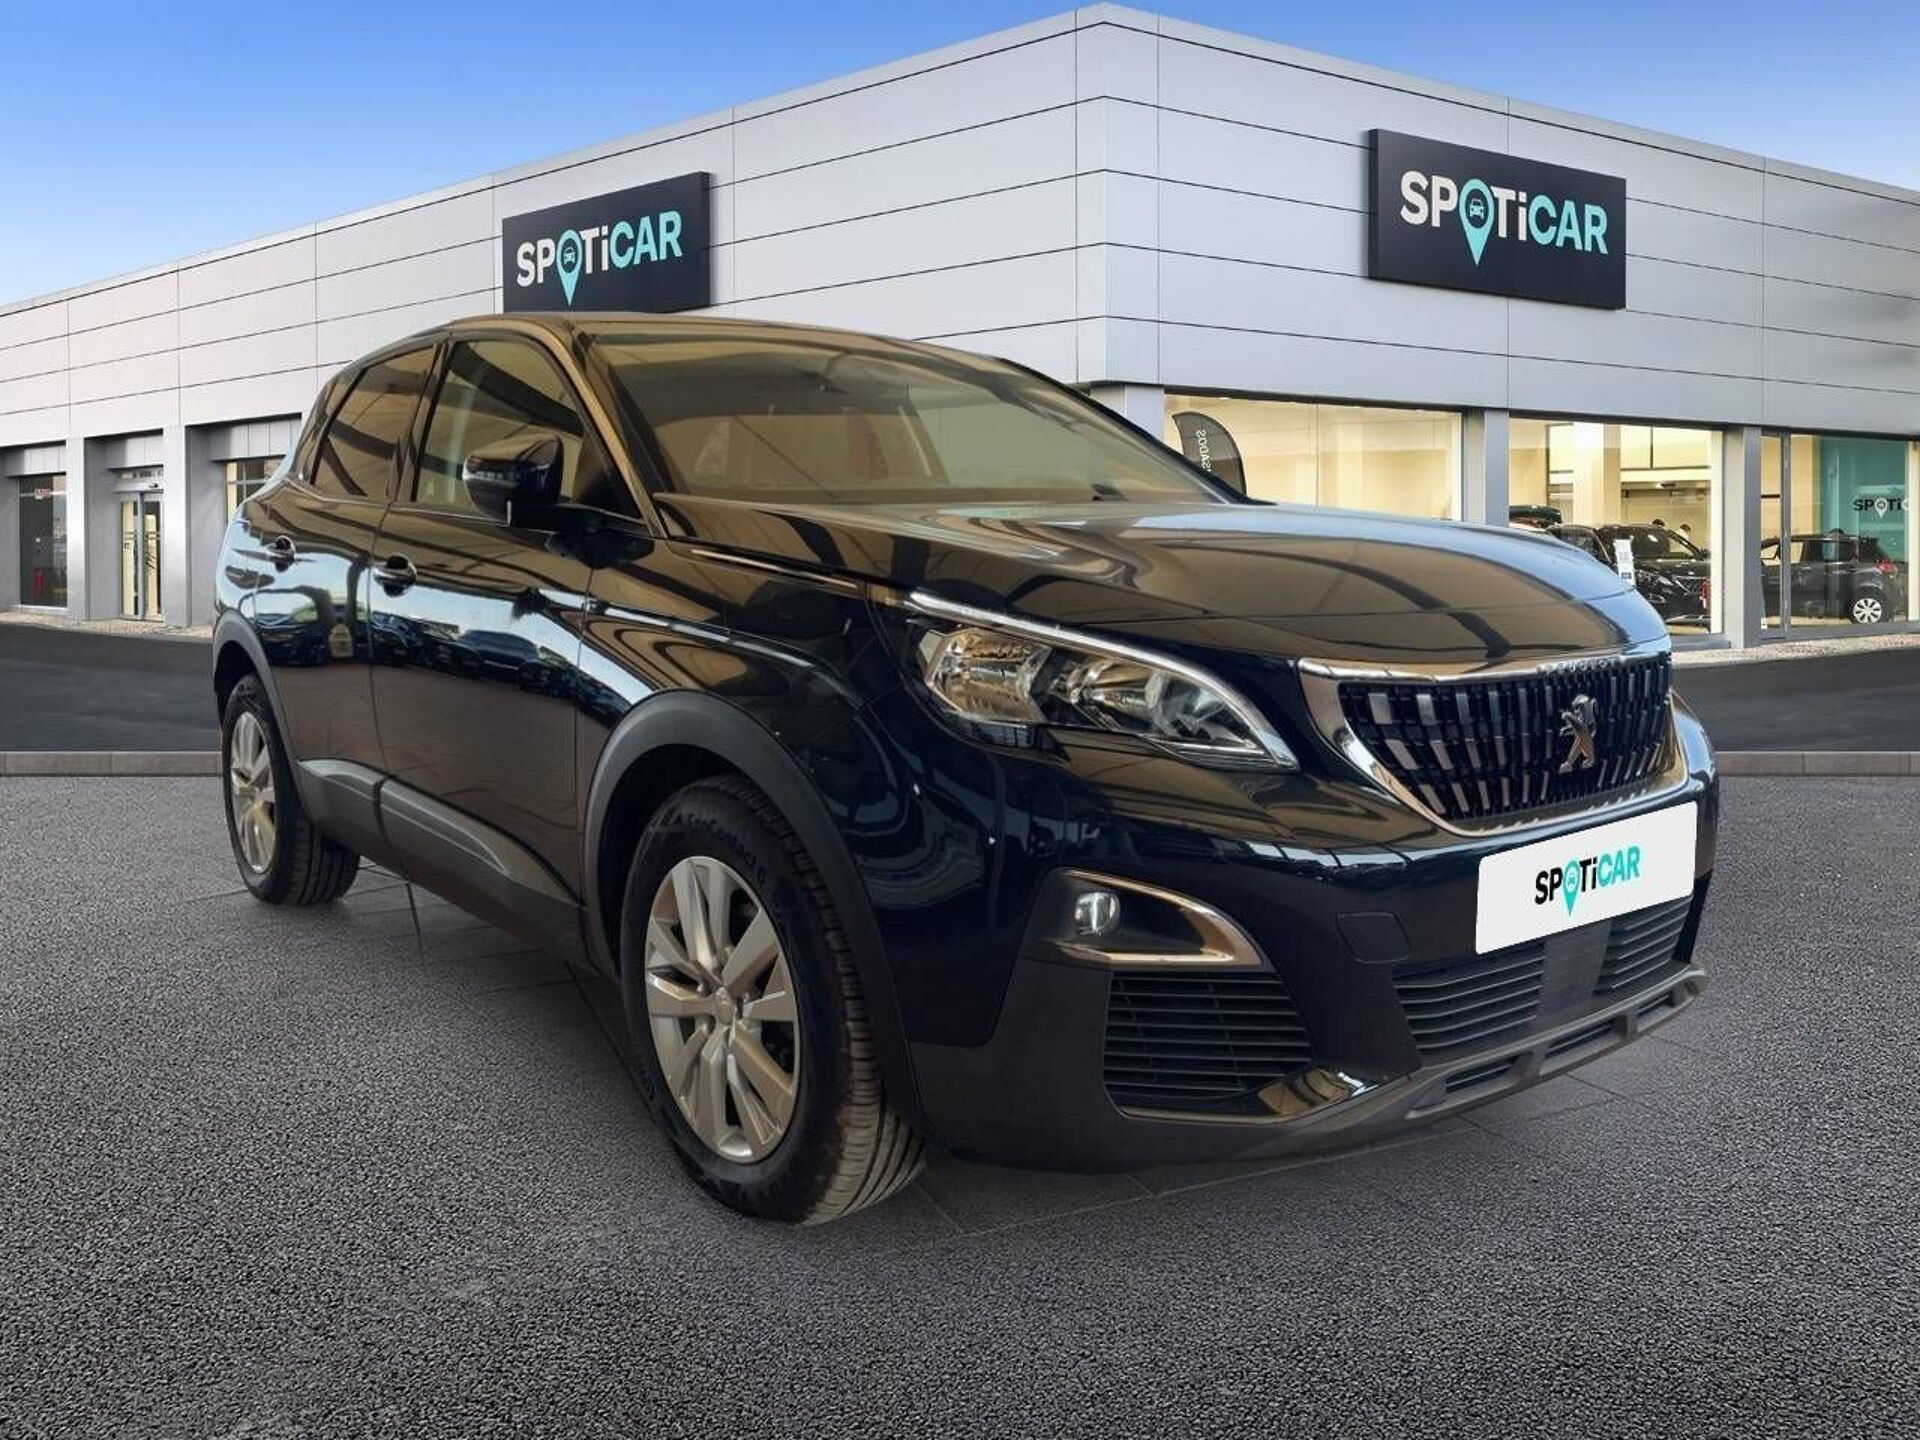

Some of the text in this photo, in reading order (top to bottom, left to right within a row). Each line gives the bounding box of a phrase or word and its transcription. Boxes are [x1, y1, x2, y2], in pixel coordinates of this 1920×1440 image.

[516, 210, 683, 307] SPOTiCAR
[1400, 171, 1608, 265] SPOTiCAR
[1534, 846, 1640, 917] SPOTiCAR
